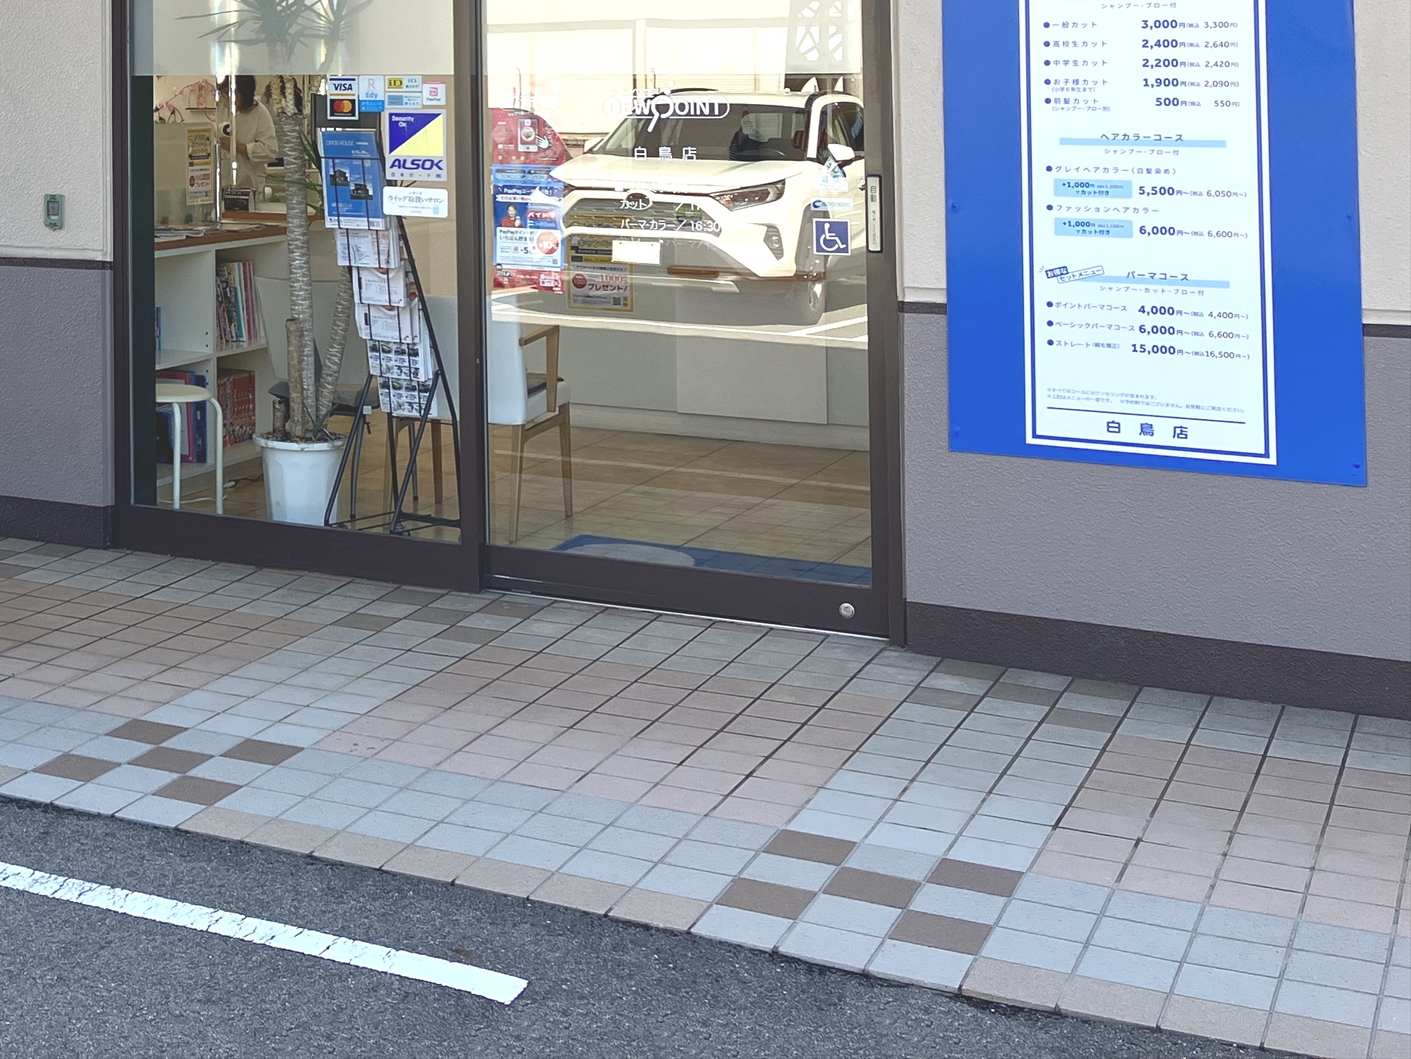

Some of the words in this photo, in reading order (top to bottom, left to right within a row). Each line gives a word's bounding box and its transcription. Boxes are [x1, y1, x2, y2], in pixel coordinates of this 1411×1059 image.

[332, 83, 353, 92] VISA
[365, 91, 378, 99] Edy
[391, 115, 415, 123] Security
[1100, 132, 1185, 142] ヘアカラーコース
[634, 146, 697, 161] 白鳥店
[389, 158, 444, 171] ALSOK
[1126, 270, 1189, 282] パーマコース
[1106, 420, 1190, 440] 白鳥店
